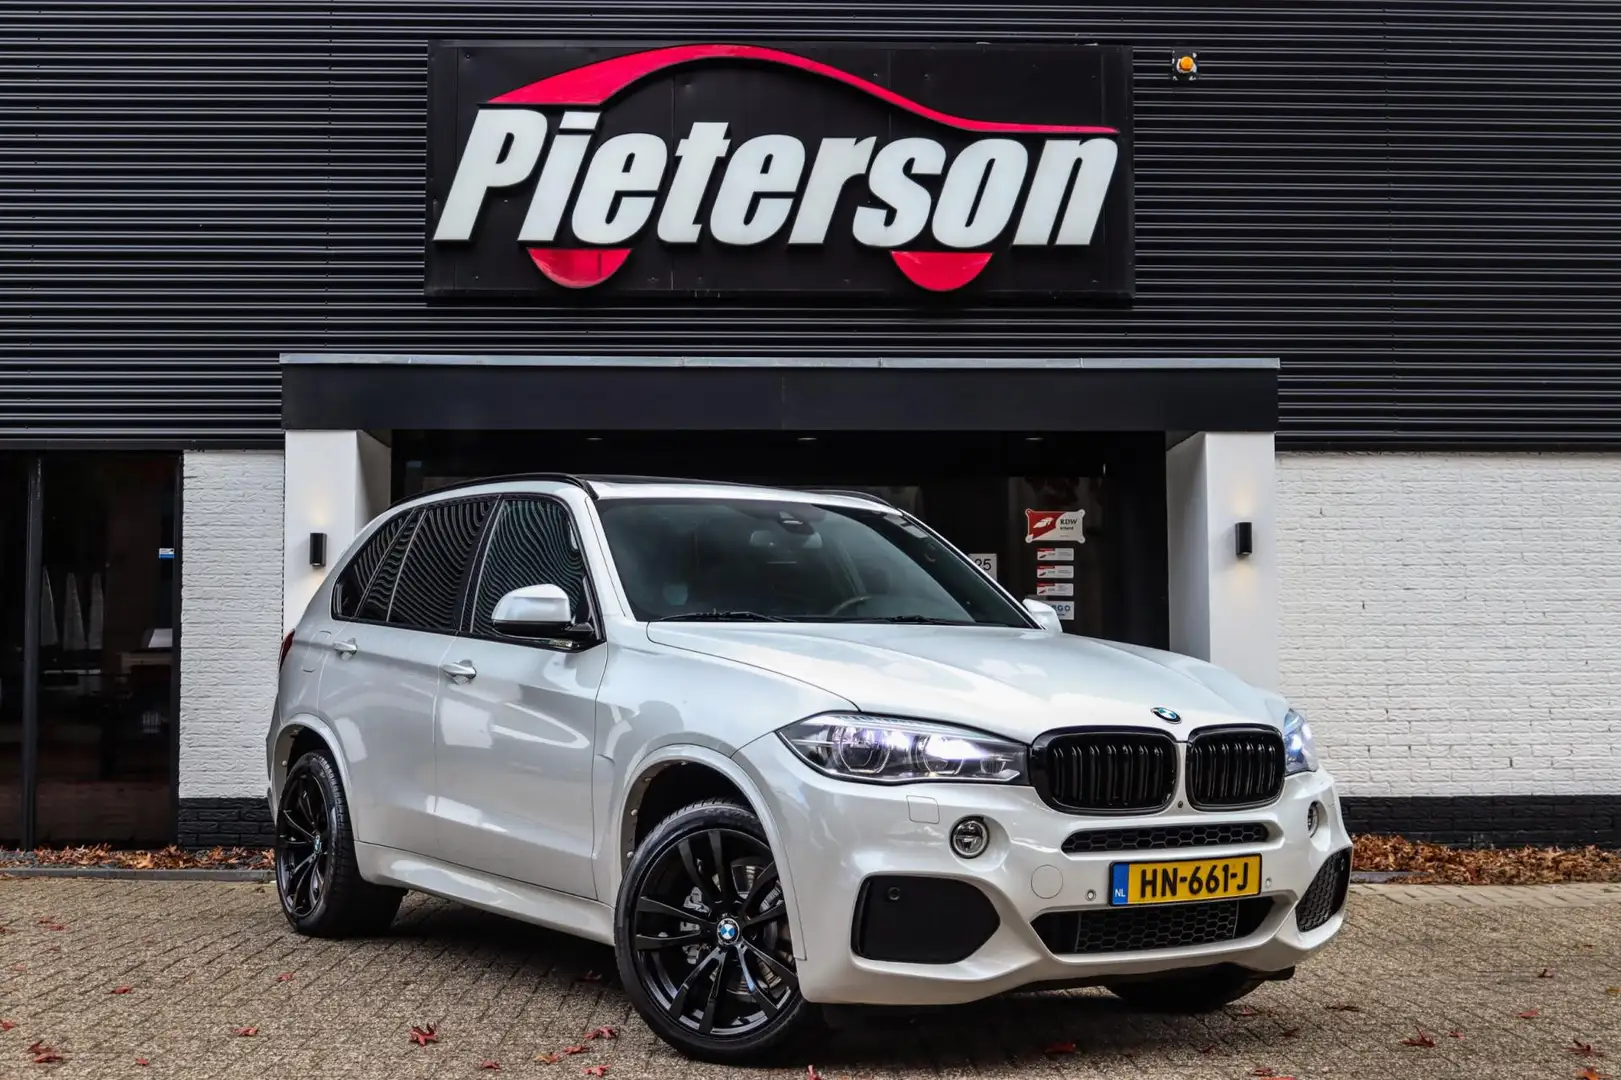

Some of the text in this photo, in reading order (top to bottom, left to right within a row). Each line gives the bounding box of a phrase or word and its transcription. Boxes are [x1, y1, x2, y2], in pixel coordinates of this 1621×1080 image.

[433, 108, 1118, 249] Pieterson
[1114, 888, 1126, 897] NL
[1140, 862, 1249, 898] HN-661-J
